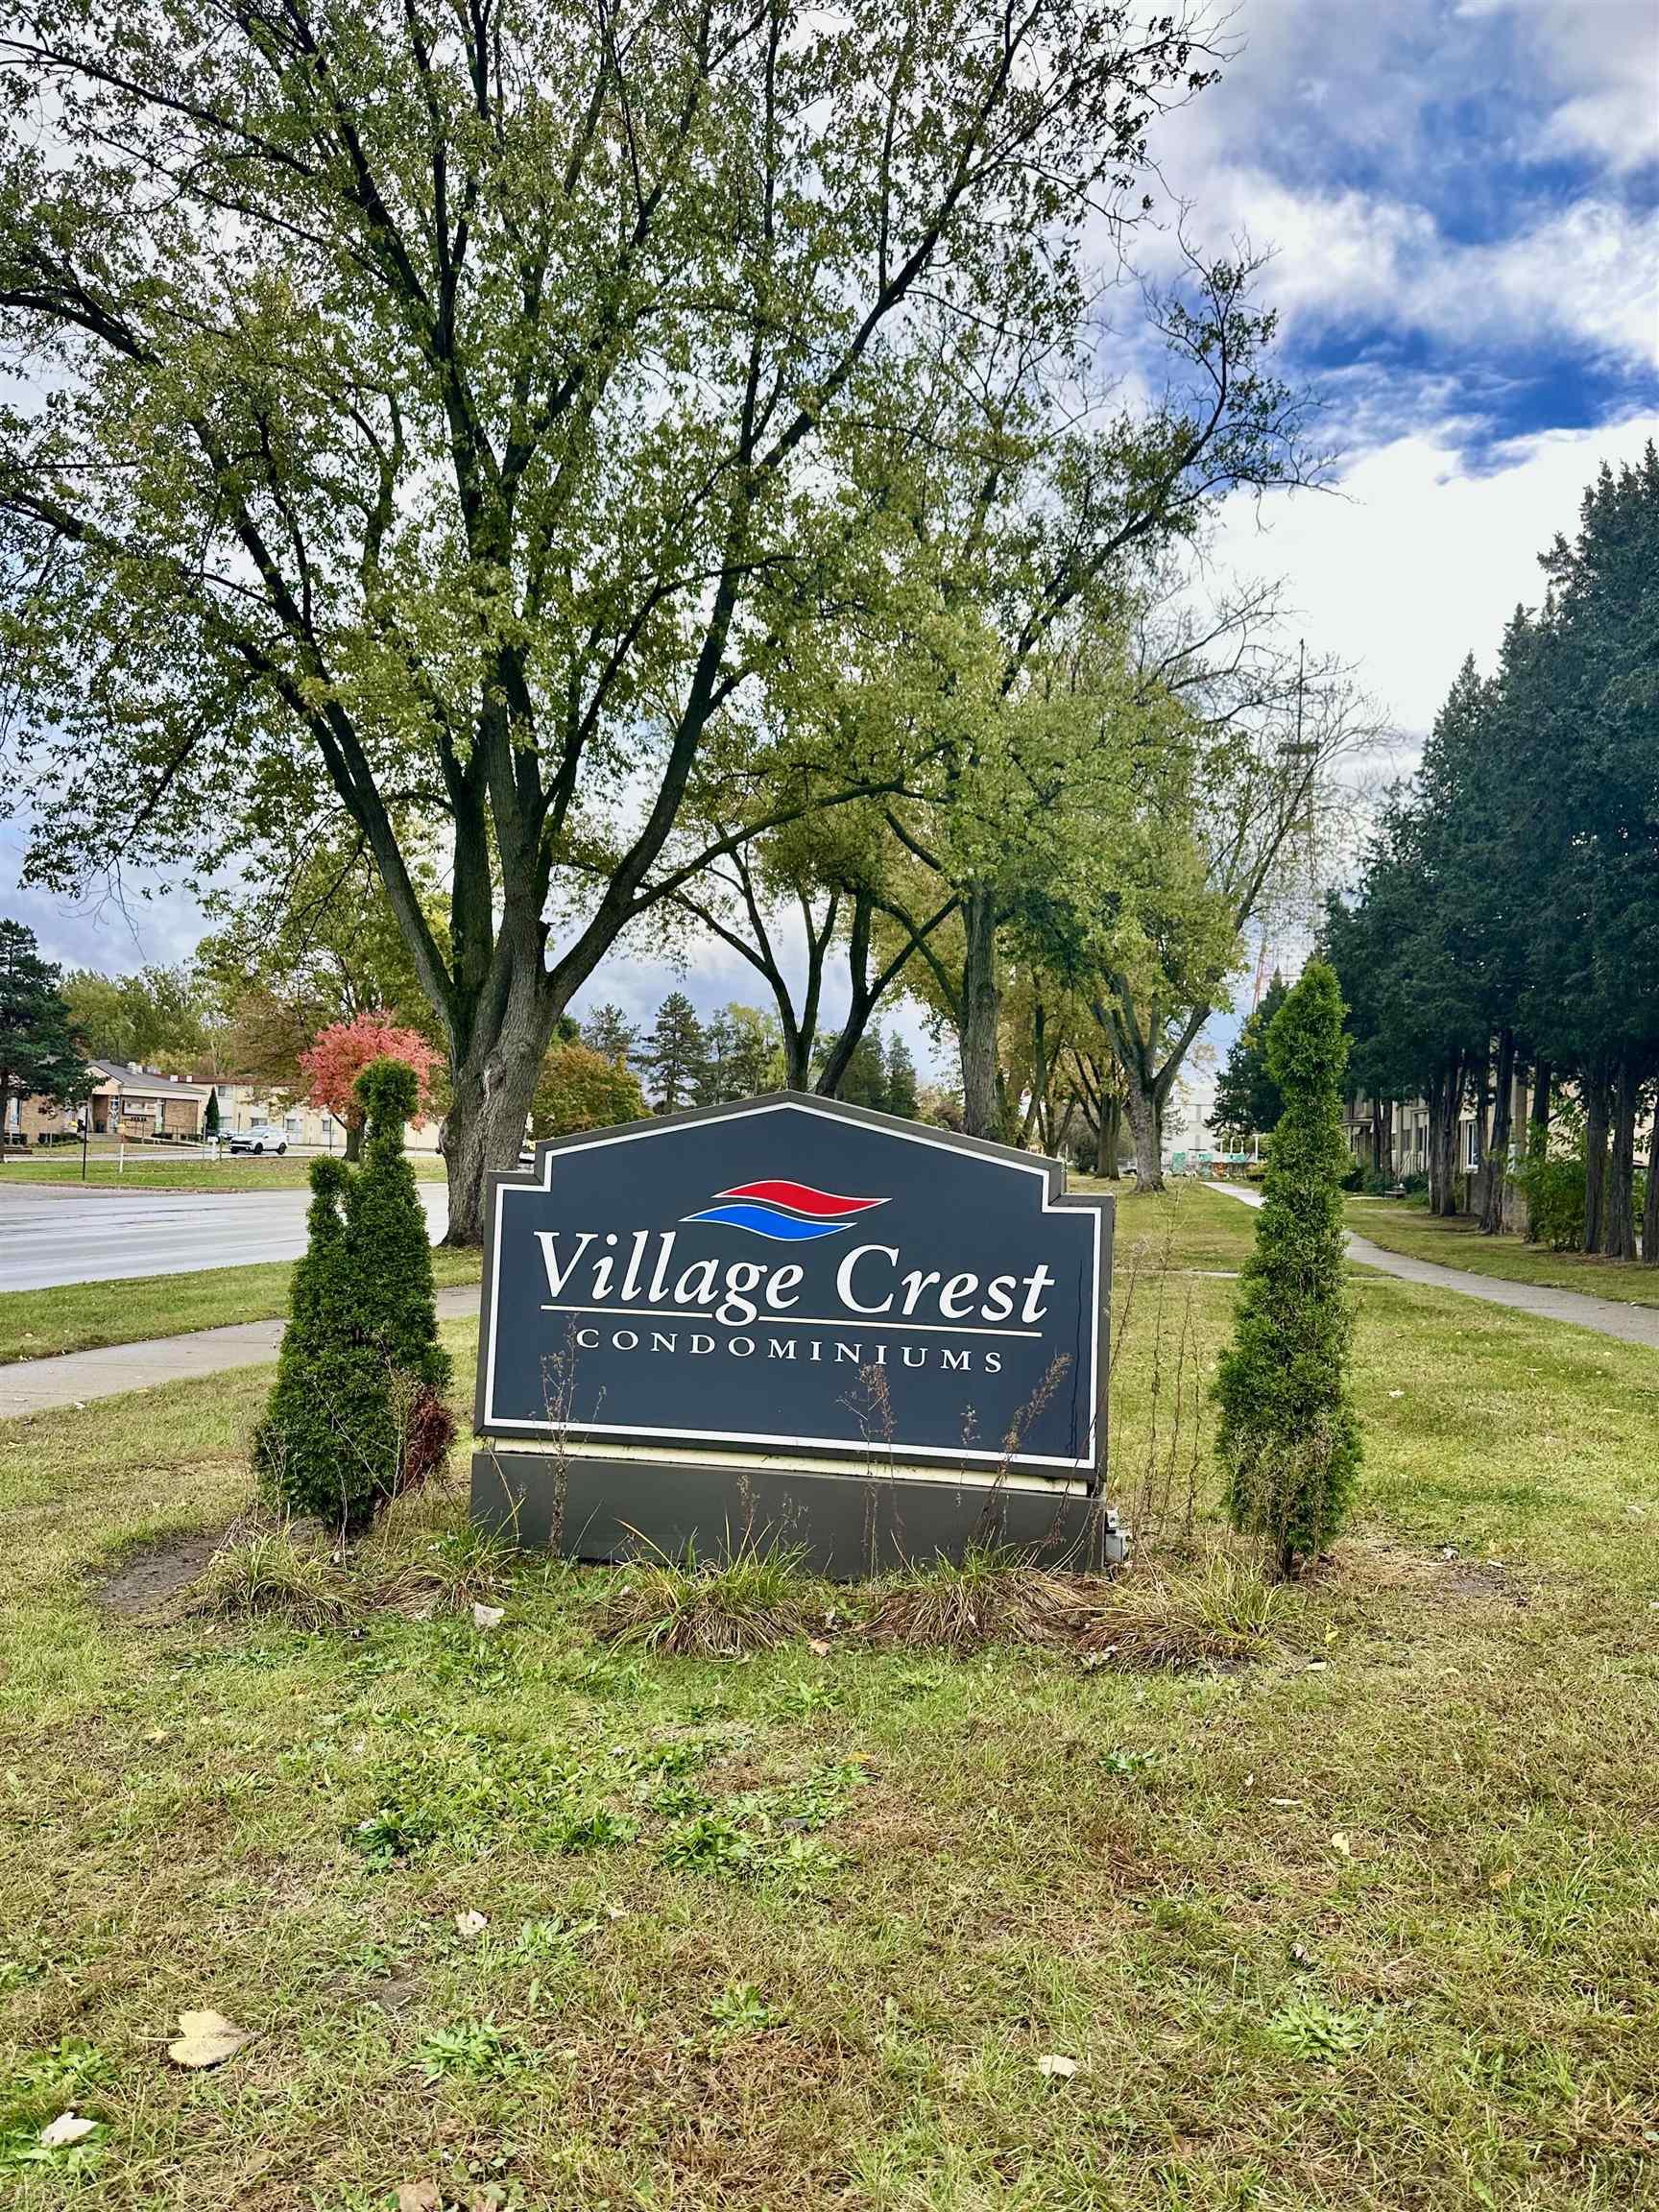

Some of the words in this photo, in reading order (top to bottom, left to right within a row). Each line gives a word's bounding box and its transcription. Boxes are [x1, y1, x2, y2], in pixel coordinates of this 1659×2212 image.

[533, 1229, 805, 1327] Village
[836, 1244, 1055, 1324] Crest
[576, 1328, 1002, 1373] CONDOMINIUMS
